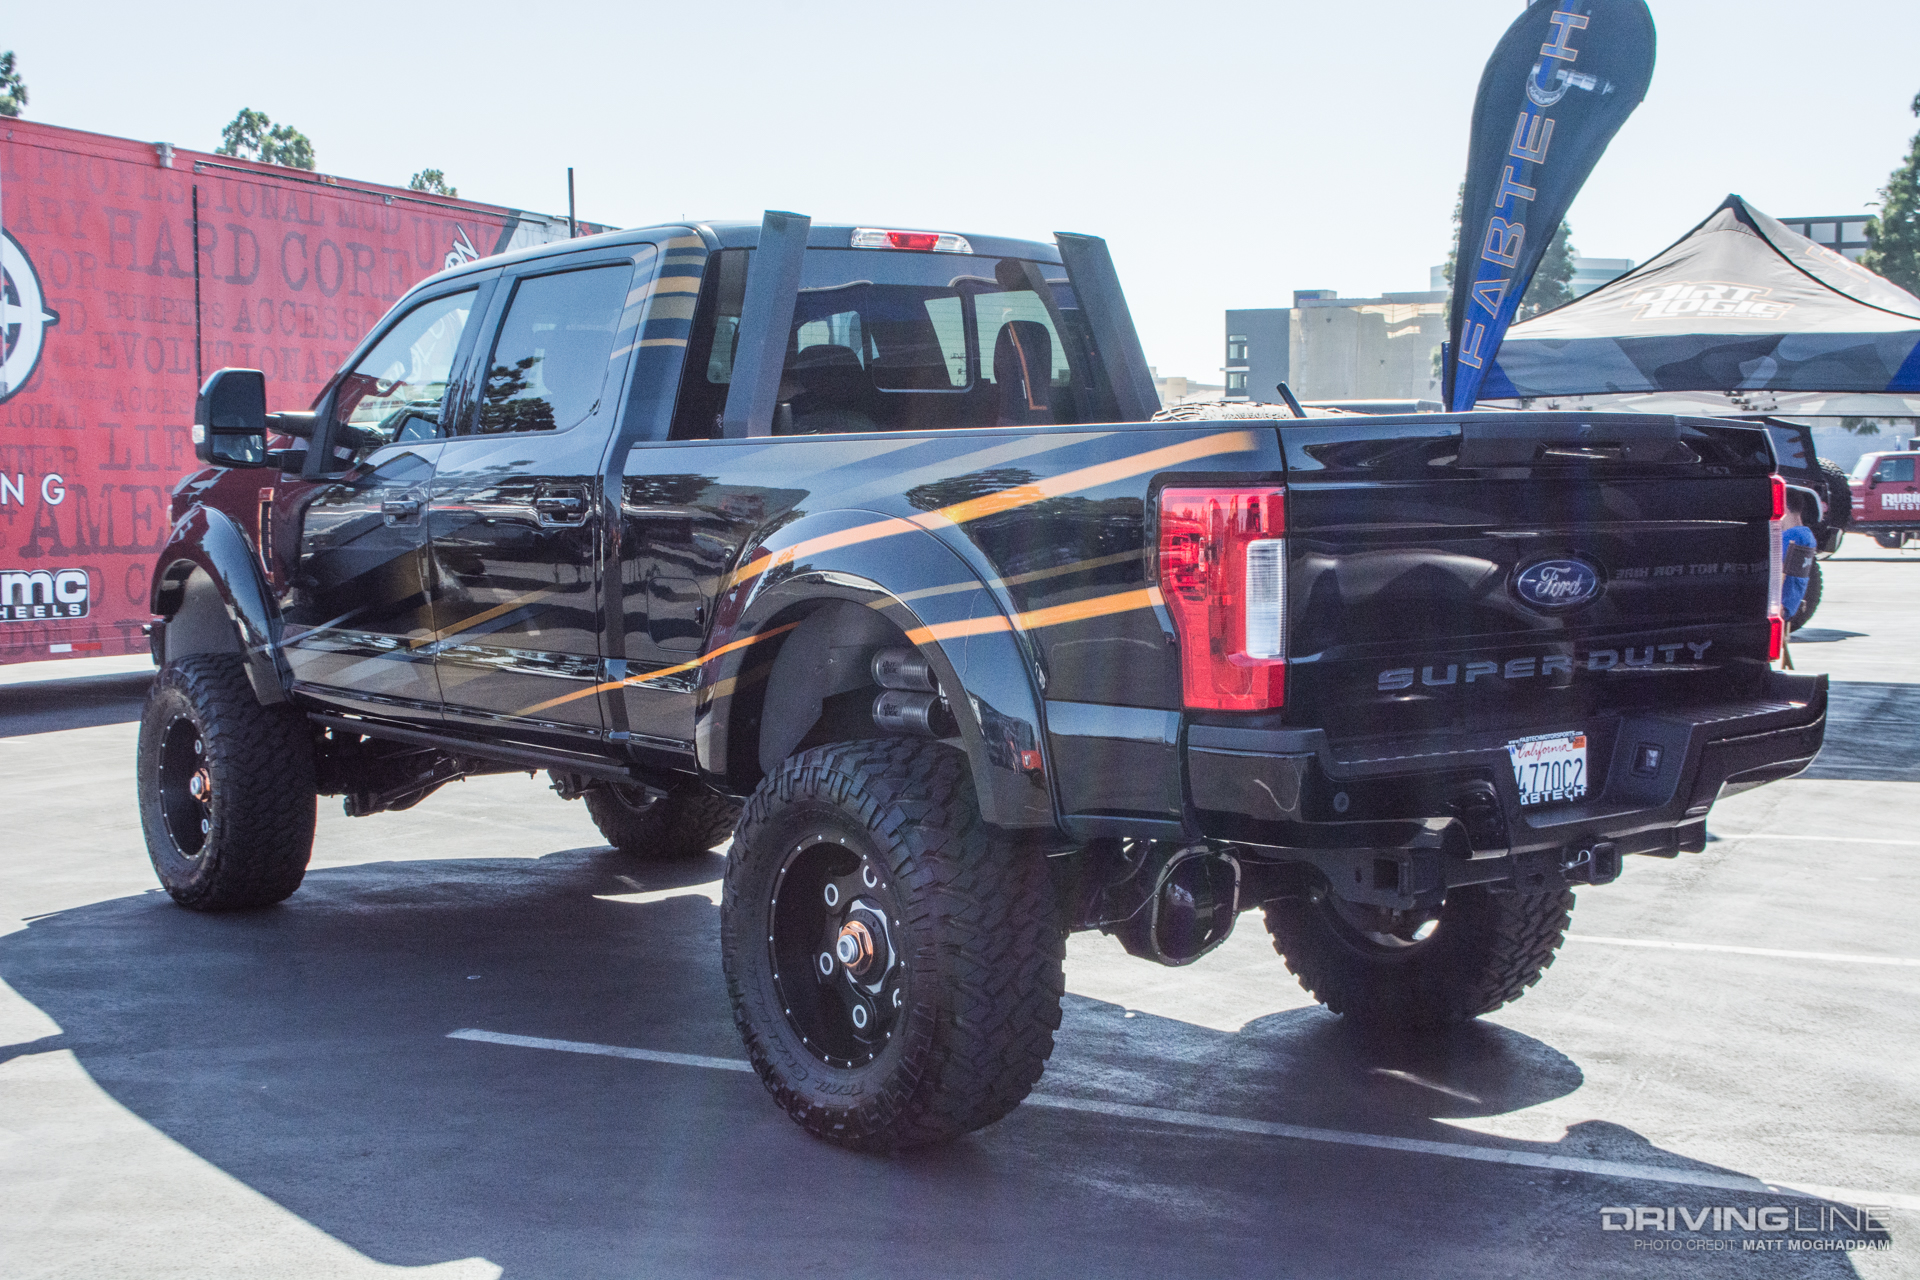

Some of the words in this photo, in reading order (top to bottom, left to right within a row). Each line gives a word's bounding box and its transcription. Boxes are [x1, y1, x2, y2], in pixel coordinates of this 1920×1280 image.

[1458, 10, 1604, 370] FABTECH
[102, 205, 262, 286] HARD
[281, 231, 411, 303] CORE
[1632, 284, 1763, 305] DIRT
[1642, 299, 1785, 319] LOGIC
[232, 297, 388, 342] ACCESSO
[94, 330, 350, 384] EVOLUTIONAR
[1535, 567, 1582, 598] Ford
[1377, 655, 1573, 691] SUPER
[1587, 640, 1713, 671] DUTY
[1518, 741, 1572, 761] California
